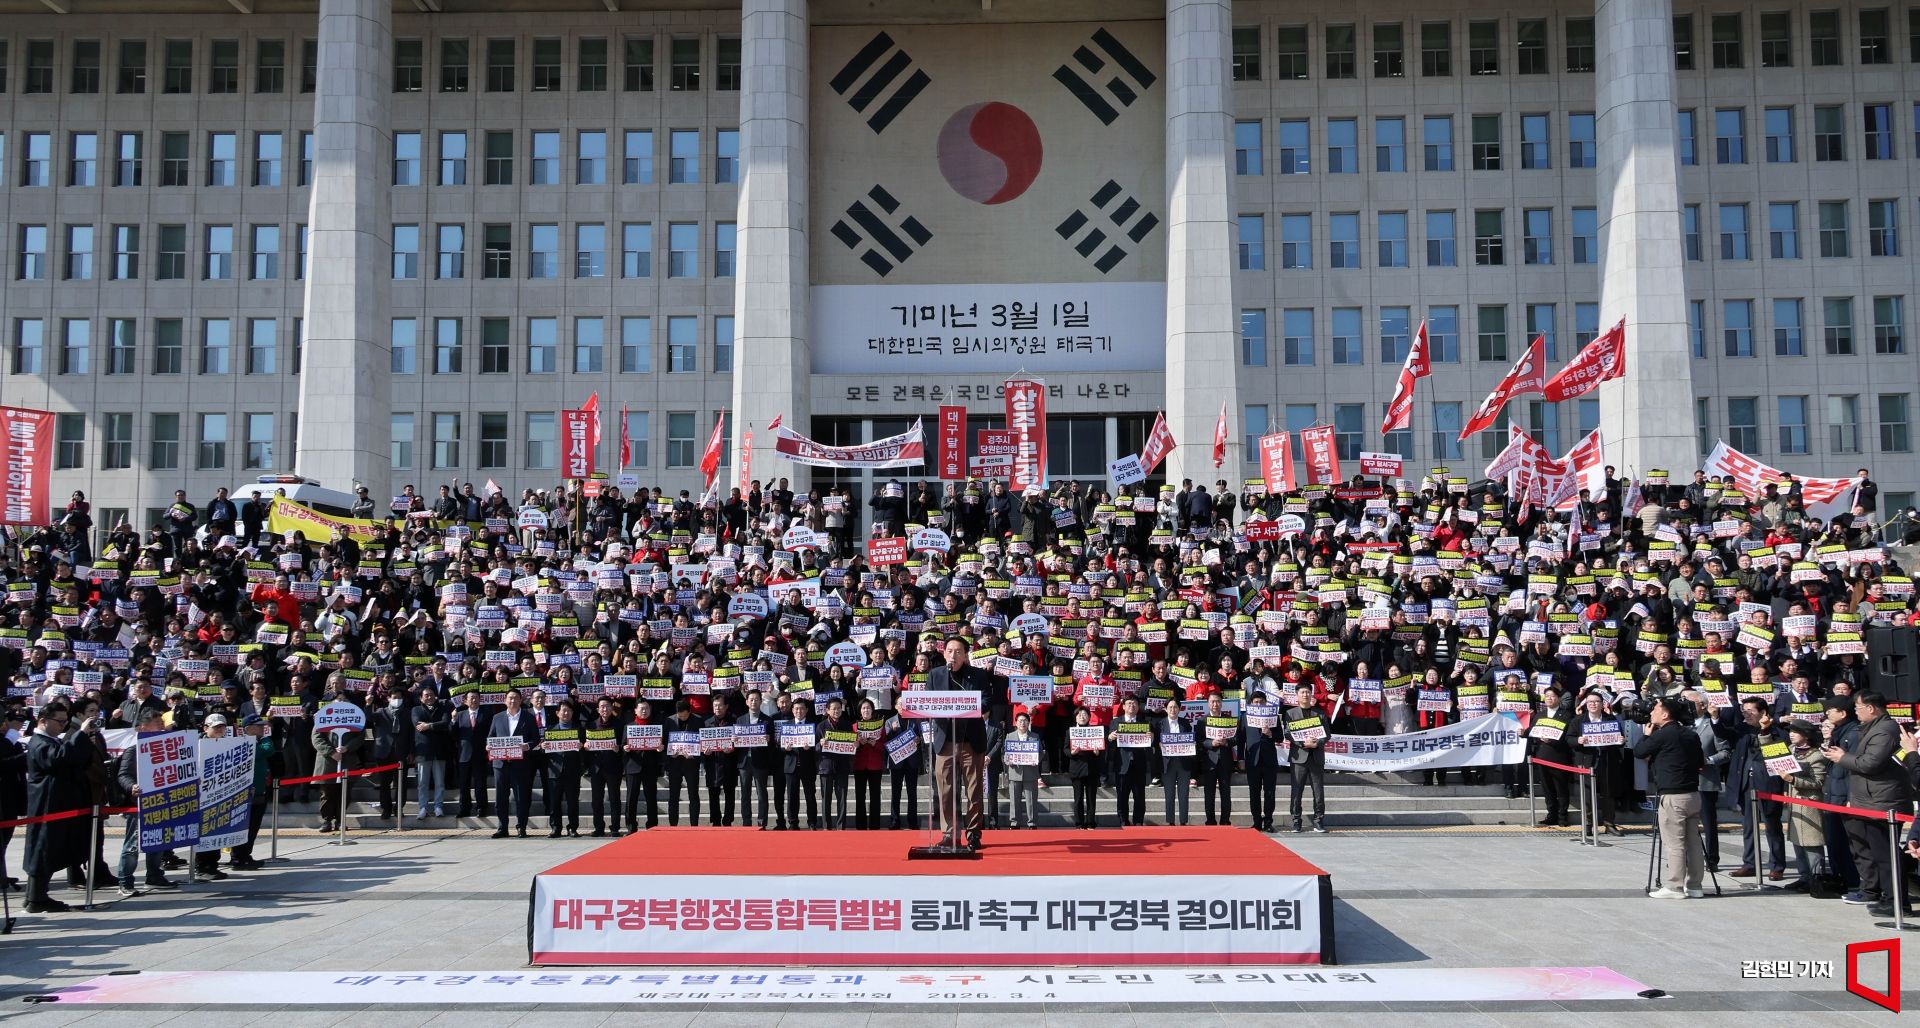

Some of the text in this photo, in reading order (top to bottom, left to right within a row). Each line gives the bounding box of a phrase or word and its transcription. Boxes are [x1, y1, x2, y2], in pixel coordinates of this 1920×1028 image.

[890, 301, 1090, 330] 기미년 3월 1일
[868, 335, 1113, 356] 대한민국 임시의정원 태극기
[846, 383, 1131, 402] 모든 권력은 국민으터 나온다
[1305, 427, 1332, 440] 대구
[987, 435, 1011, 445] 경주시
[1263, 434, 1287, 449] 대구
[569, 420, 588, 477] 달서갑
[980, 445, 1018, 454] 당원협의회
[853, 446, 901, 462] 결의대회
[1117, 460, 1138, 471] 국민의힘
[1115, 473, 1125, 482] 대구
[1246, 526, 1278, 537] 대구 서구
[1716, 622, 1733, 630] 조장하는
[1738, 631, 1772, 648] 즉시 추진하라
[96, 650, 112, 658] 광주전남
[1571, 644, 1592, 654] 추진하라
[862, 668, 877, 677] 광주전남
[1350, 679, 1365, 689] 광주전남
[653, 689, 673, 699] 추진하라
[1017, 688, 1047, 697] 상주문경
[1083, 686, 1114, 696] 국민분열 조장하는
[1420, 691, 1436, 700] 광주전남
[1419, 700, 1434, 709] 대구경북
[1459, 696, 1489, 707] 즉시 추진하라
[734, 725, 749, 735] 광주전남
[782, 725, 797, 734] 광주전남
[1071, 728, 1104, 738] 국민분열 조장하는
[1207, 727, 1237, 738] 즉시 추진하라
[1583, 723, 1601, 734] 광주전남
[504, 737, 522, 746] 조장하는
[782, 736, 797, 746] 대구경북
[1118, 734, 1128, 745] 즉시
[1162, 734, 1178, 743] 광주전남
[1352, 743, 1380, 753] 통과
[1381, 742, 1408, 753] 촉구
[1412, 736, 1467, 753] 대구경북
[1468, 730, 1520, 747] 결의대회
[557, 740, 579, 749] 추진하라
[823, 743, 856, 753] 즉시 추진하라
[886, 738, 902, 752] 광주전남
[1006, 741, 1021, 751] 광주전남
[1006, 753, 1022, 763] 대구경북
[152, 761, 197, 787] 살길이다!
[202, 777, 216, 792] 국가
[144, 799, 199, 825] 지방세 공공기관
[552, 898, 1302, 932] 대구경북행정통합특별법 통과 촉구 대구경북 결의대회
[895, 973, 986, 986] 촉구
[1014, 972, 1155, 986] 시도민
[1184, 971, 1377, 985] 결의대회
[634, 991, 894, 1001] 재경대구경북시도민회
